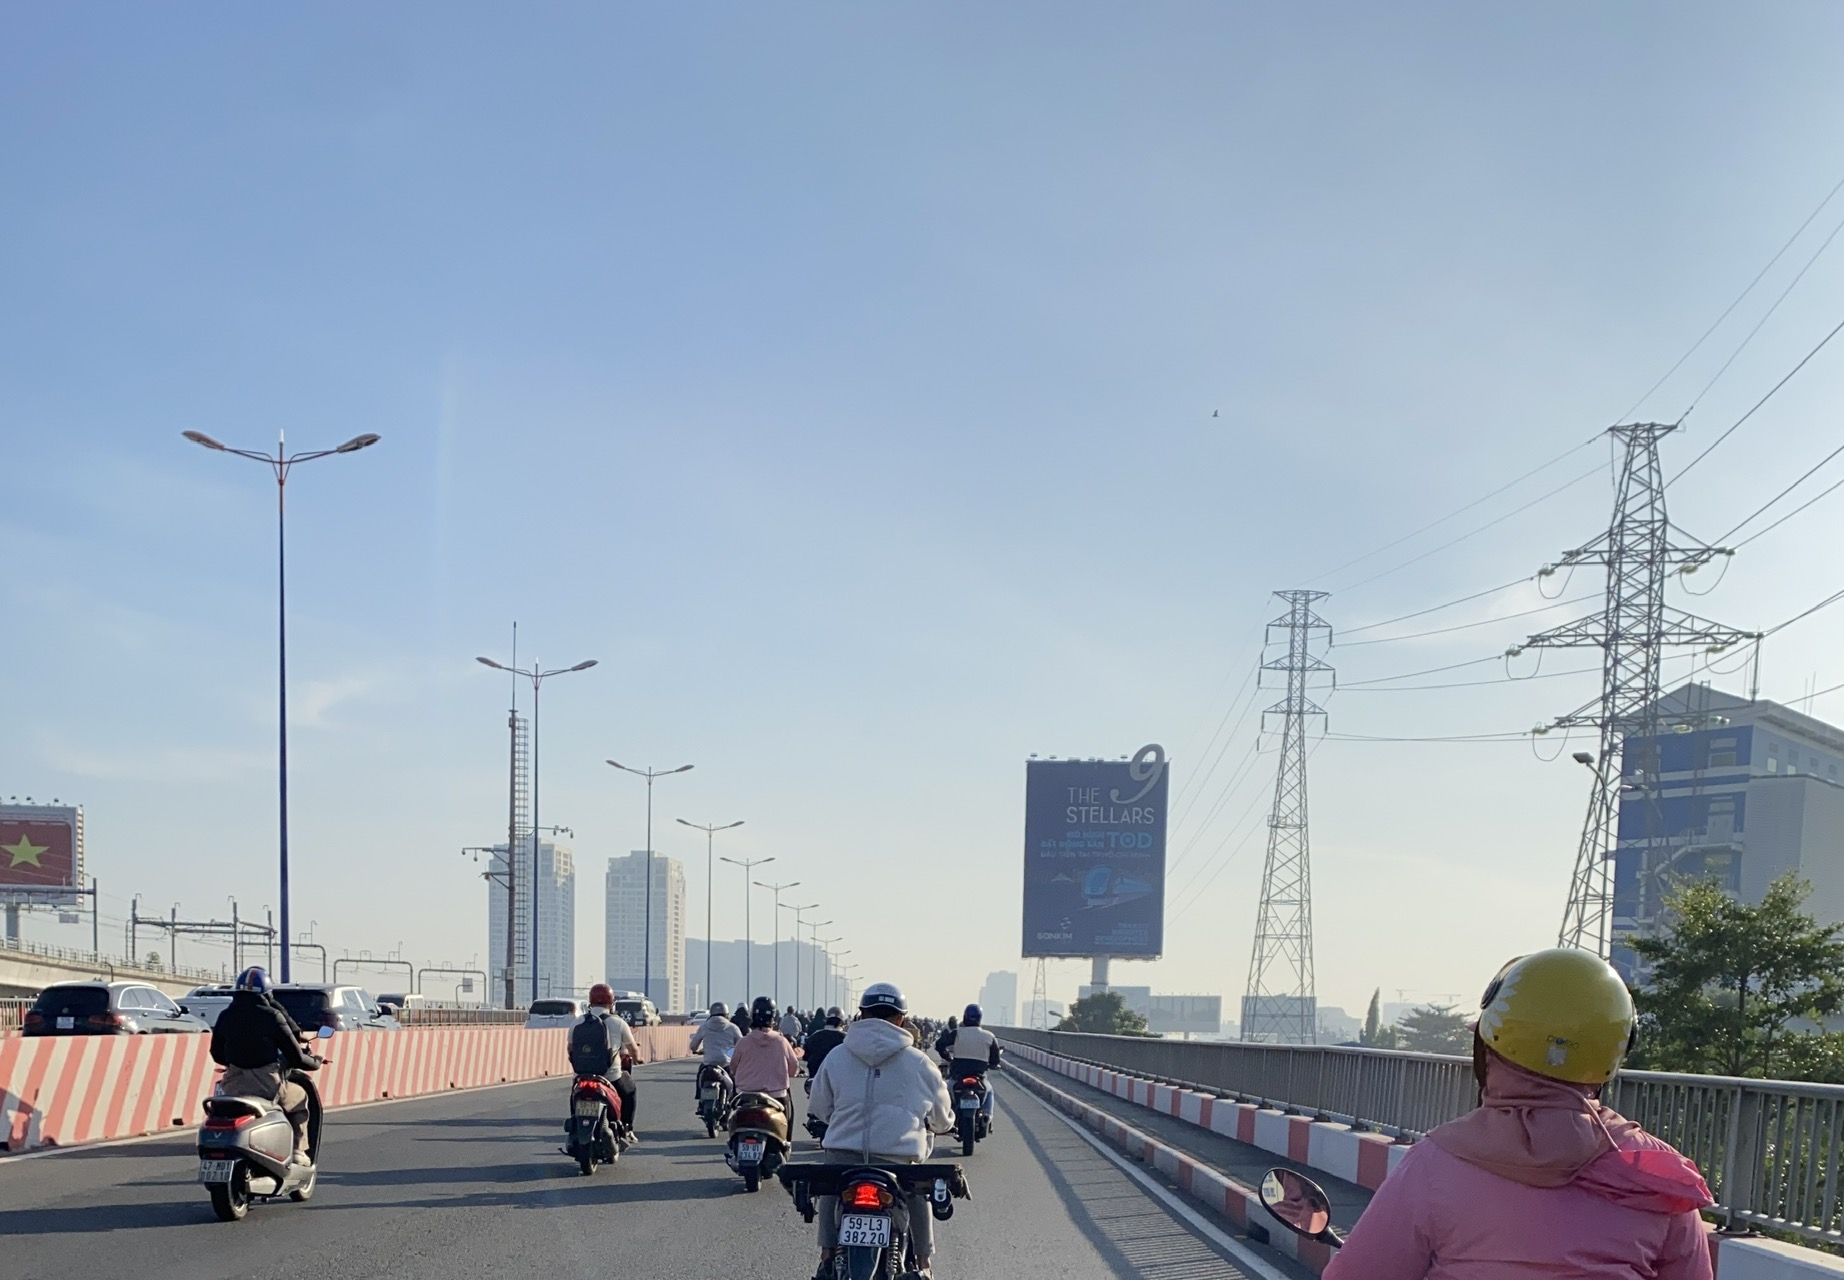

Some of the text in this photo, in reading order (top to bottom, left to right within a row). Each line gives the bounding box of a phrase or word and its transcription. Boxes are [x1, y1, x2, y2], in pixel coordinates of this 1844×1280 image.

[1110, 743, 1165, 804] 9
[1067, 787, 1100, 804] THE
[1066, 807, 1155, 824] STELLARS
[1107, 832, 1153, 849] TOD
[849, 1217, 883, 1231] 59-L3
[843, 1230, 885, 1245] 382.20
